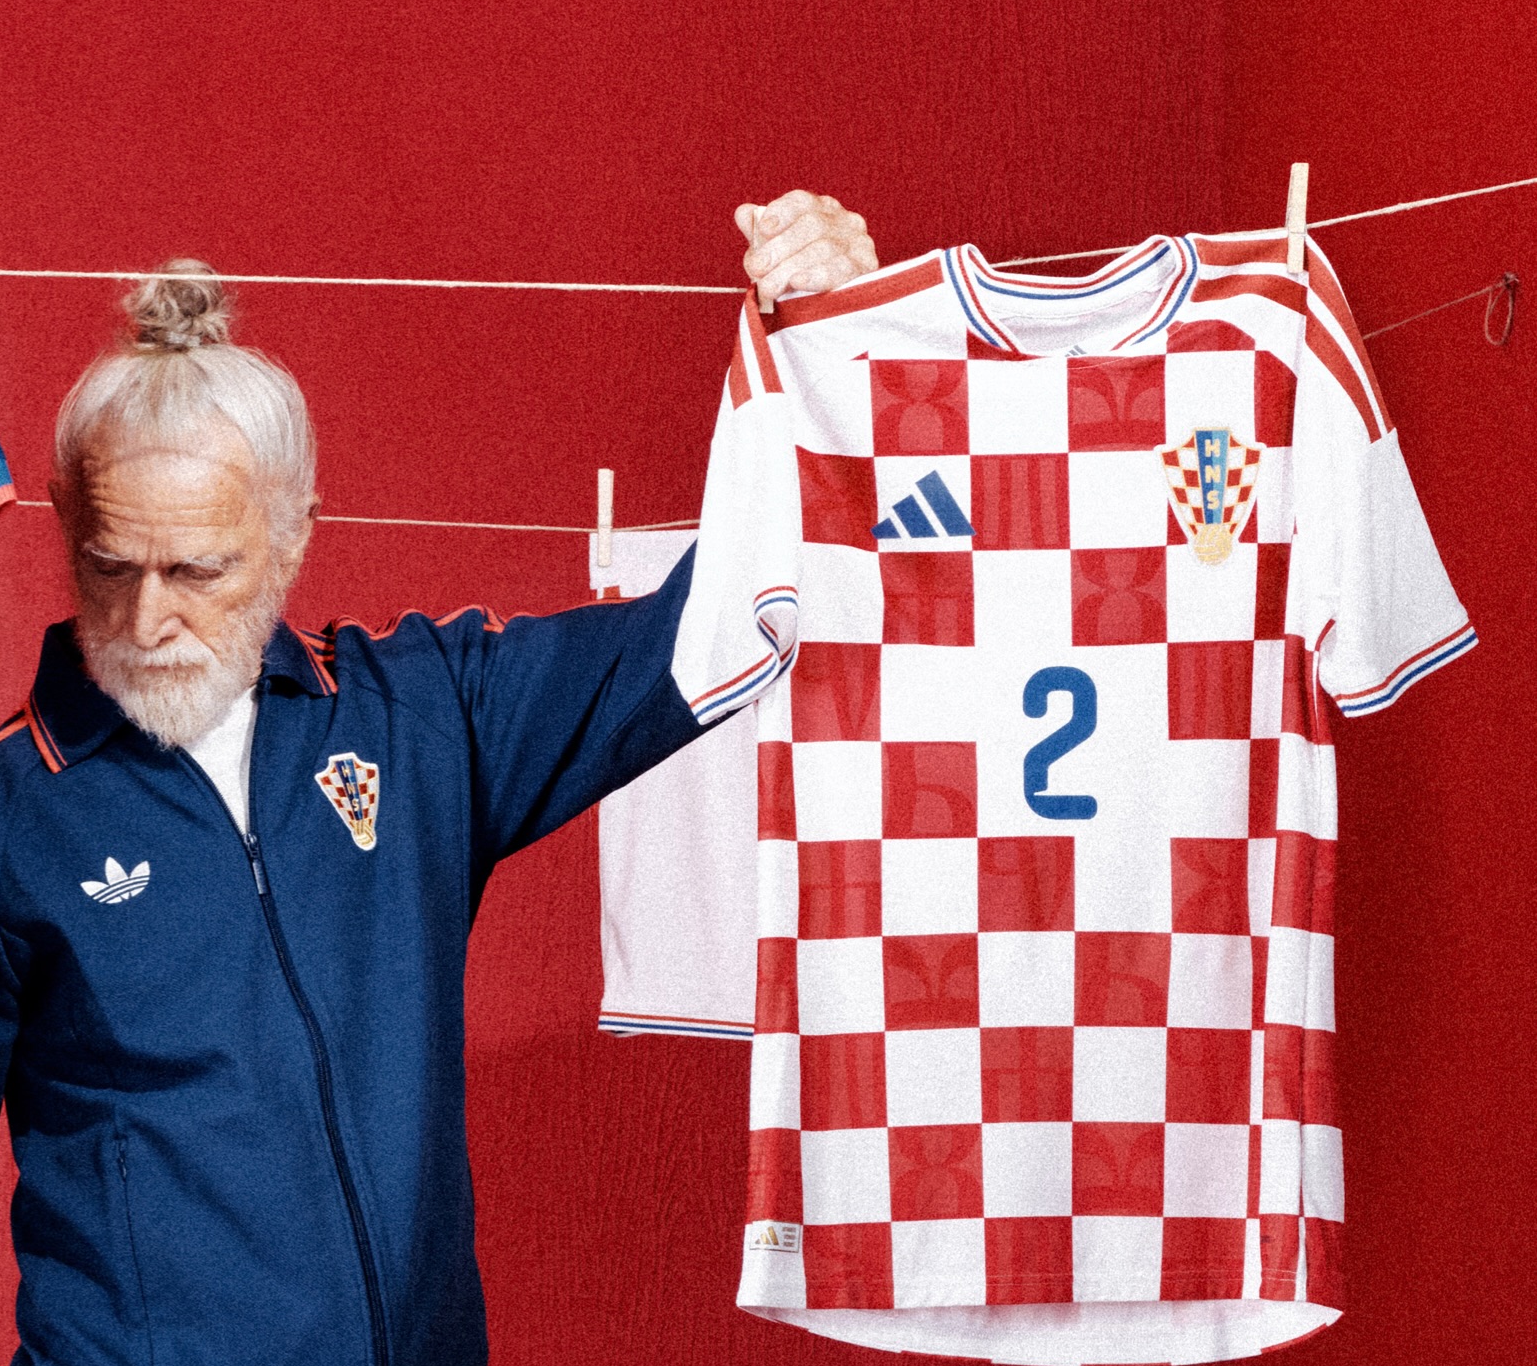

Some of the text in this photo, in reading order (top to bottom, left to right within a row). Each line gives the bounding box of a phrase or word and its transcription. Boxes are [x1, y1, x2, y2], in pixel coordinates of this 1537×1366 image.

[1204, 439, 1221, 510] HNS
[1022, 665, 1098, 821] 2
[341, 765, 360, 812] HNS
